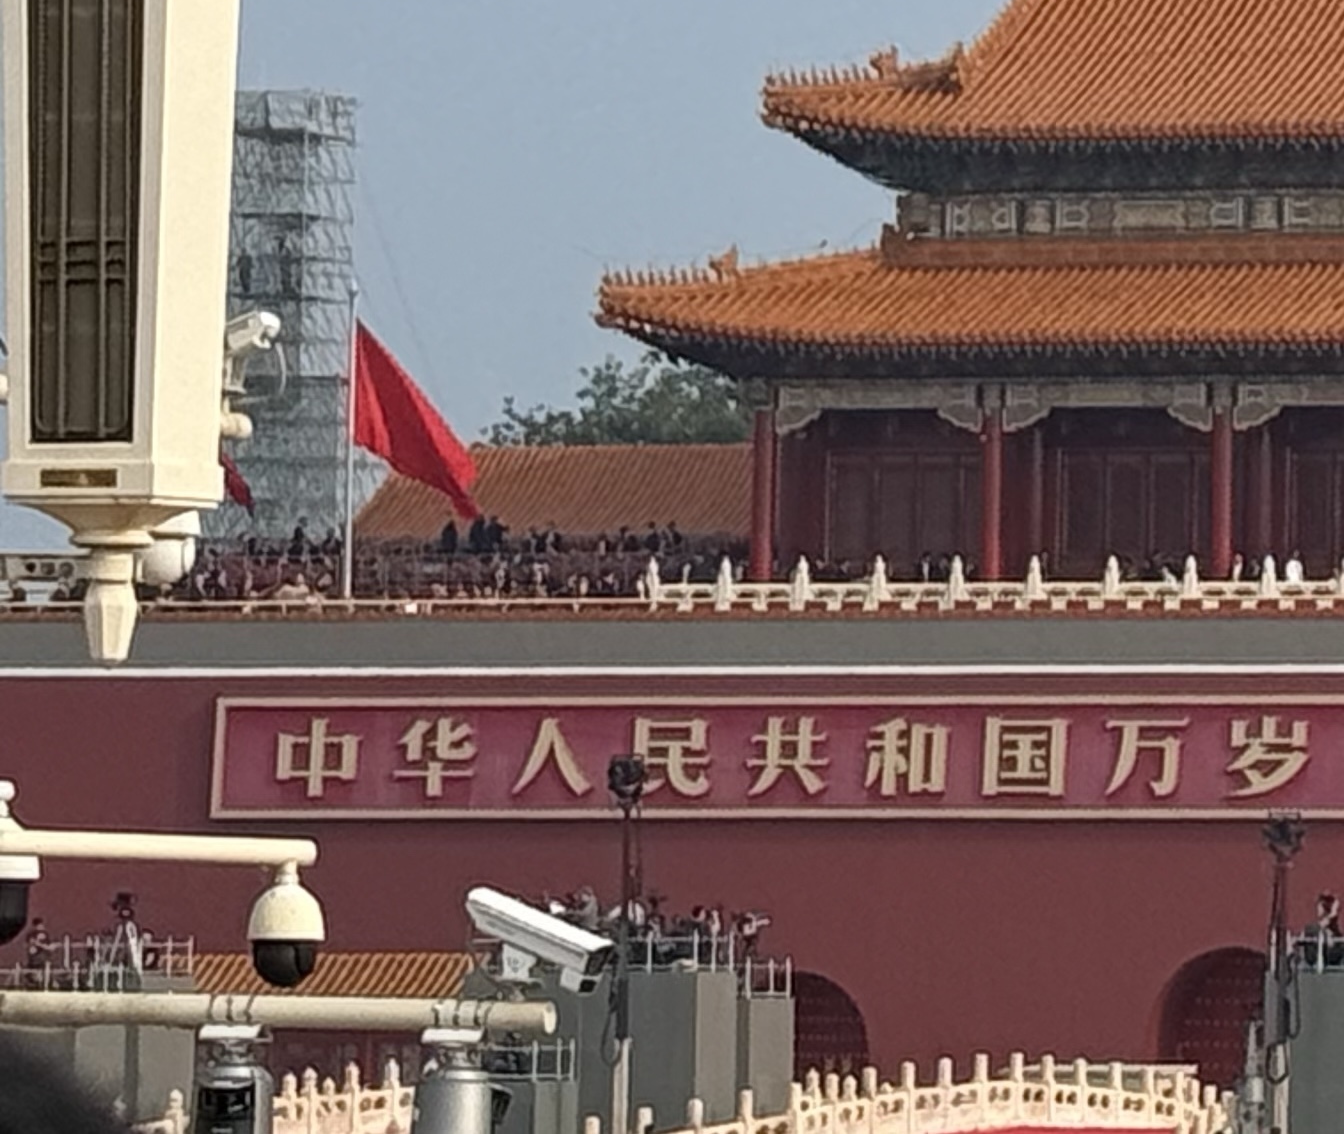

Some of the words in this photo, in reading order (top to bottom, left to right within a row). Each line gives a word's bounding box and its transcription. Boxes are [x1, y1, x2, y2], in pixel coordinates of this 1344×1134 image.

[275, 715, 1311, 798] 中华人民共和国万岁
